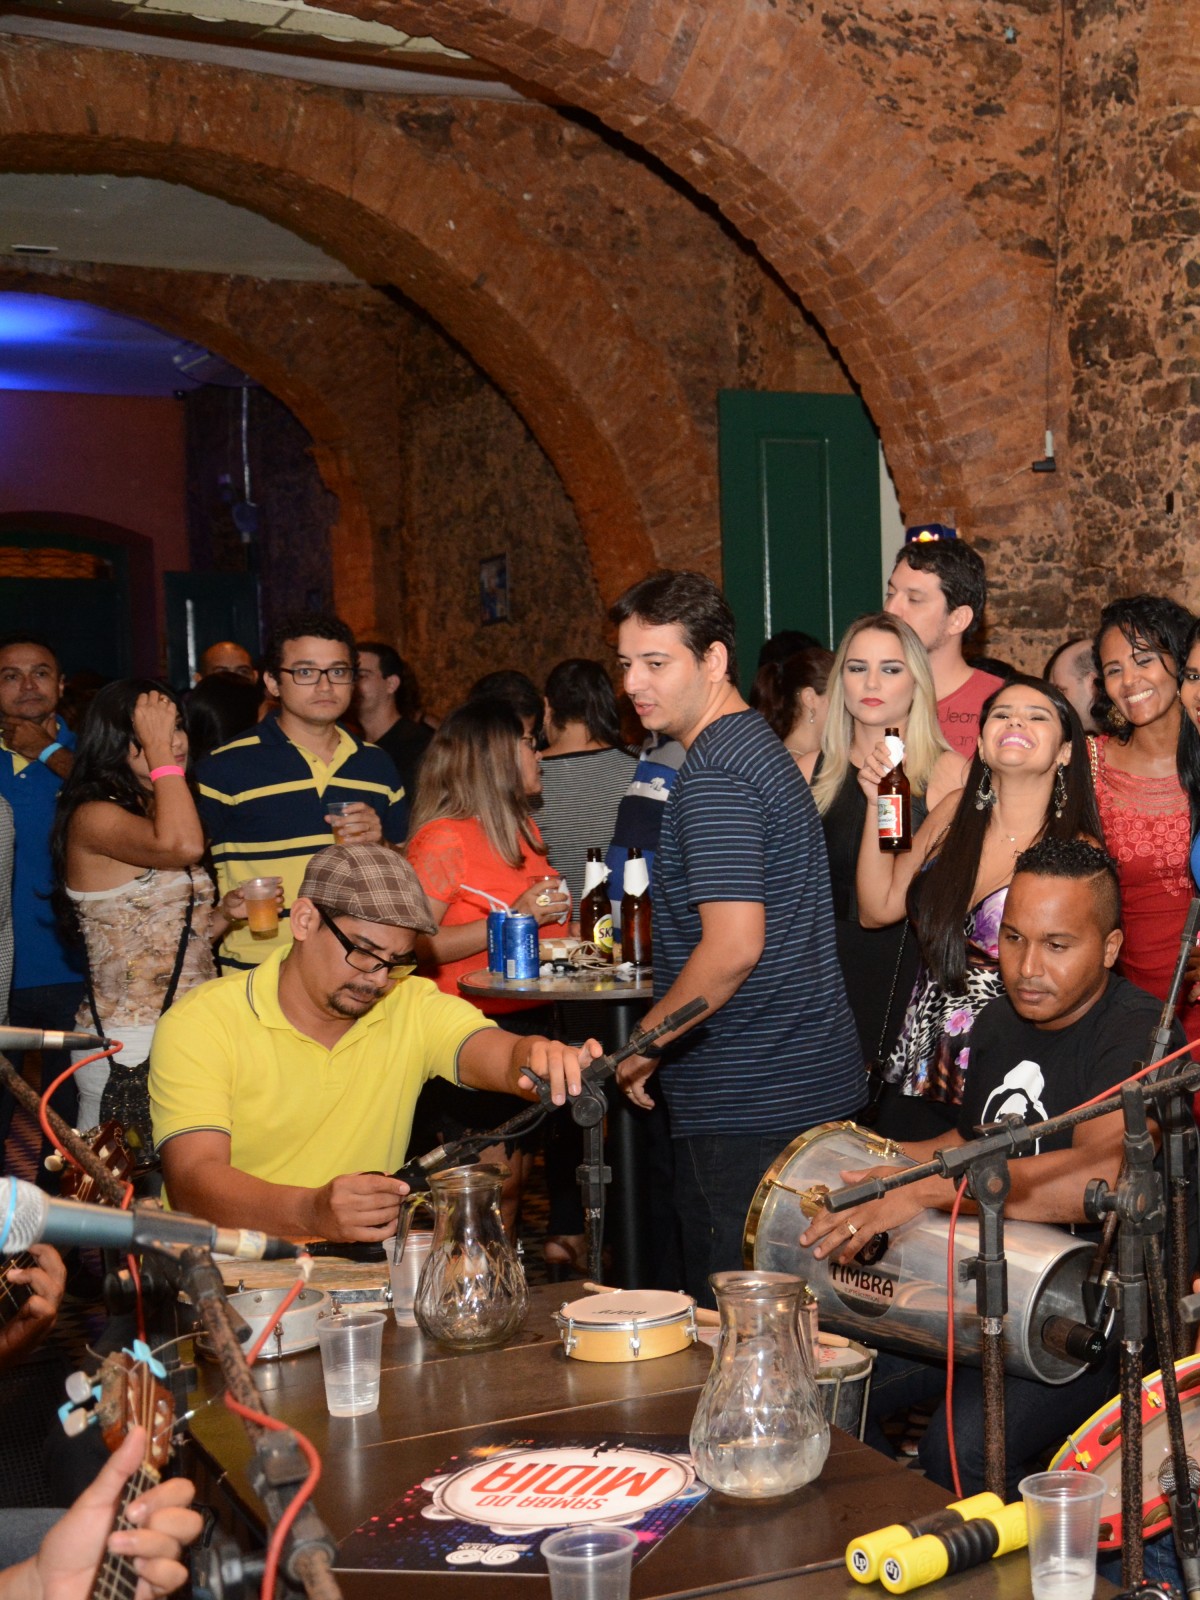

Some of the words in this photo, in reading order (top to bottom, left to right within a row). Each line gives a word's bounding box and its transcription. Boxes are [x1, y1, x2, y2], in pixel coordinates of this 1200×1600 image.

[599, 927, 614, 938] SK
[830, 1262, 894, 1298] TIMBRA
[475, 1494, 517, 1507] DO
[516, 1495, 608, 1510] SAMBA
[855, 1554, 867, 1570] LP
[886, 1562, 898, 1579] LP
